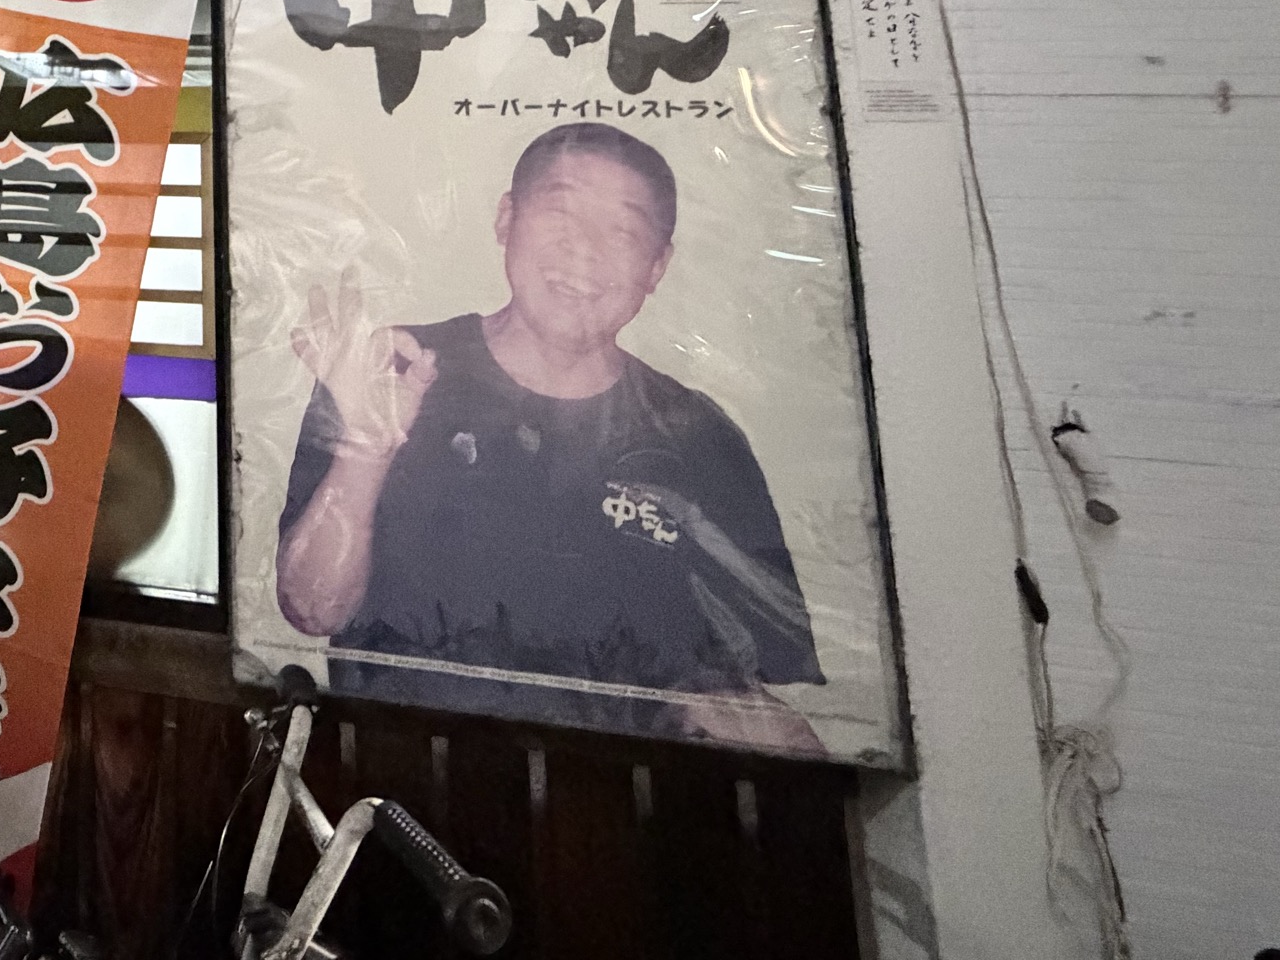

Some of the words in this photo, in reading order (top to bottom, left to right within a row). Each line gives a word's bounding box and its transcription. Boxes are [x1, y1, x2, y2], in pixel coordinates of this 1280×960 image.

[454, 98, 733, 121] オーバーナイトレストラン
